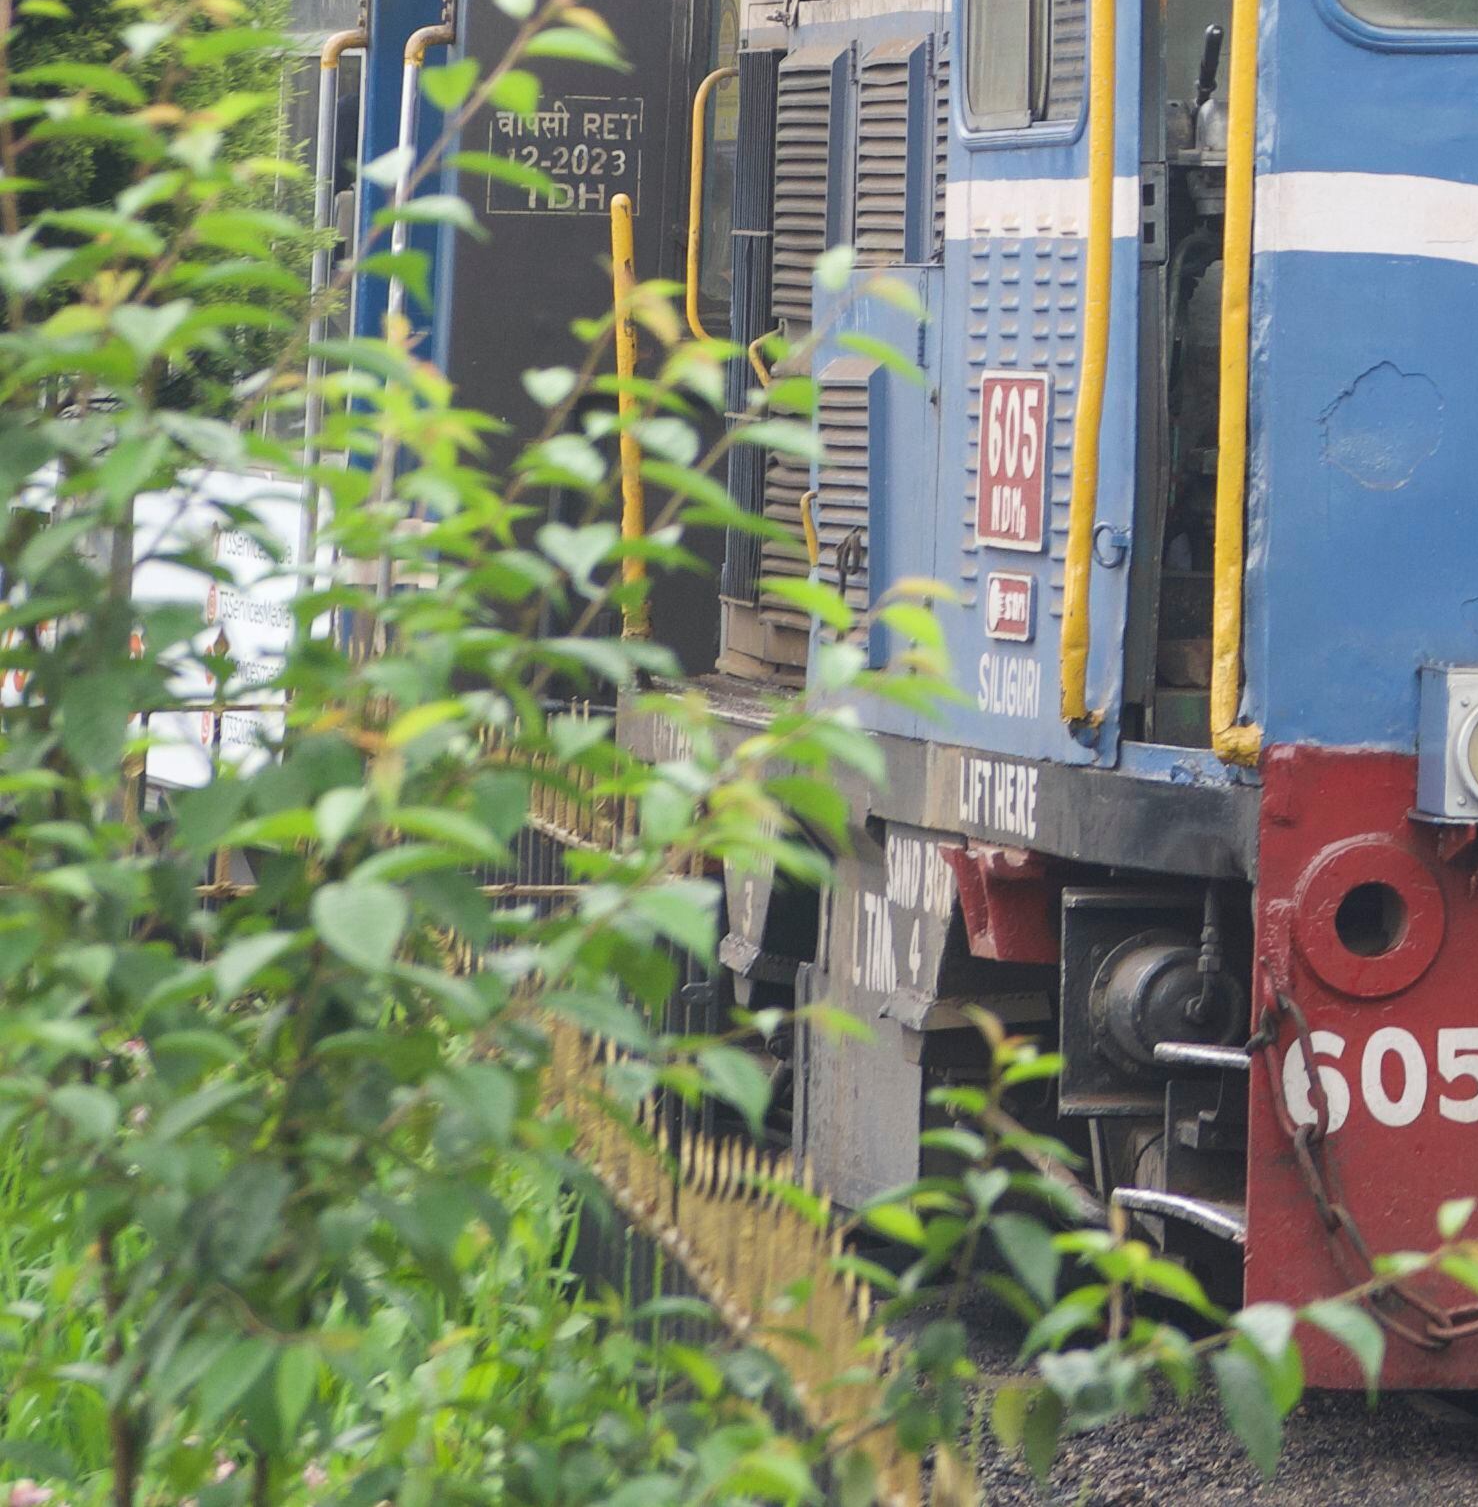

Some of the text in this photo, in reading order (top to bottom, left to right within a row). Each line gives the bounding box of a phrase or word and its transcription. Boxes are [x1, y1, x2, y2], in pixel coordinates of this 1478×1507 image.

[583, 112, 638, 141] RET
[987, 384, 1039, 480] 605
[978, 652, 1041, 719] SILIGURI
[959, 755, 1038, 840] LIFT HERE
[886, 834, 922, 910] SAND
[908, 918, 921, 985] 4
